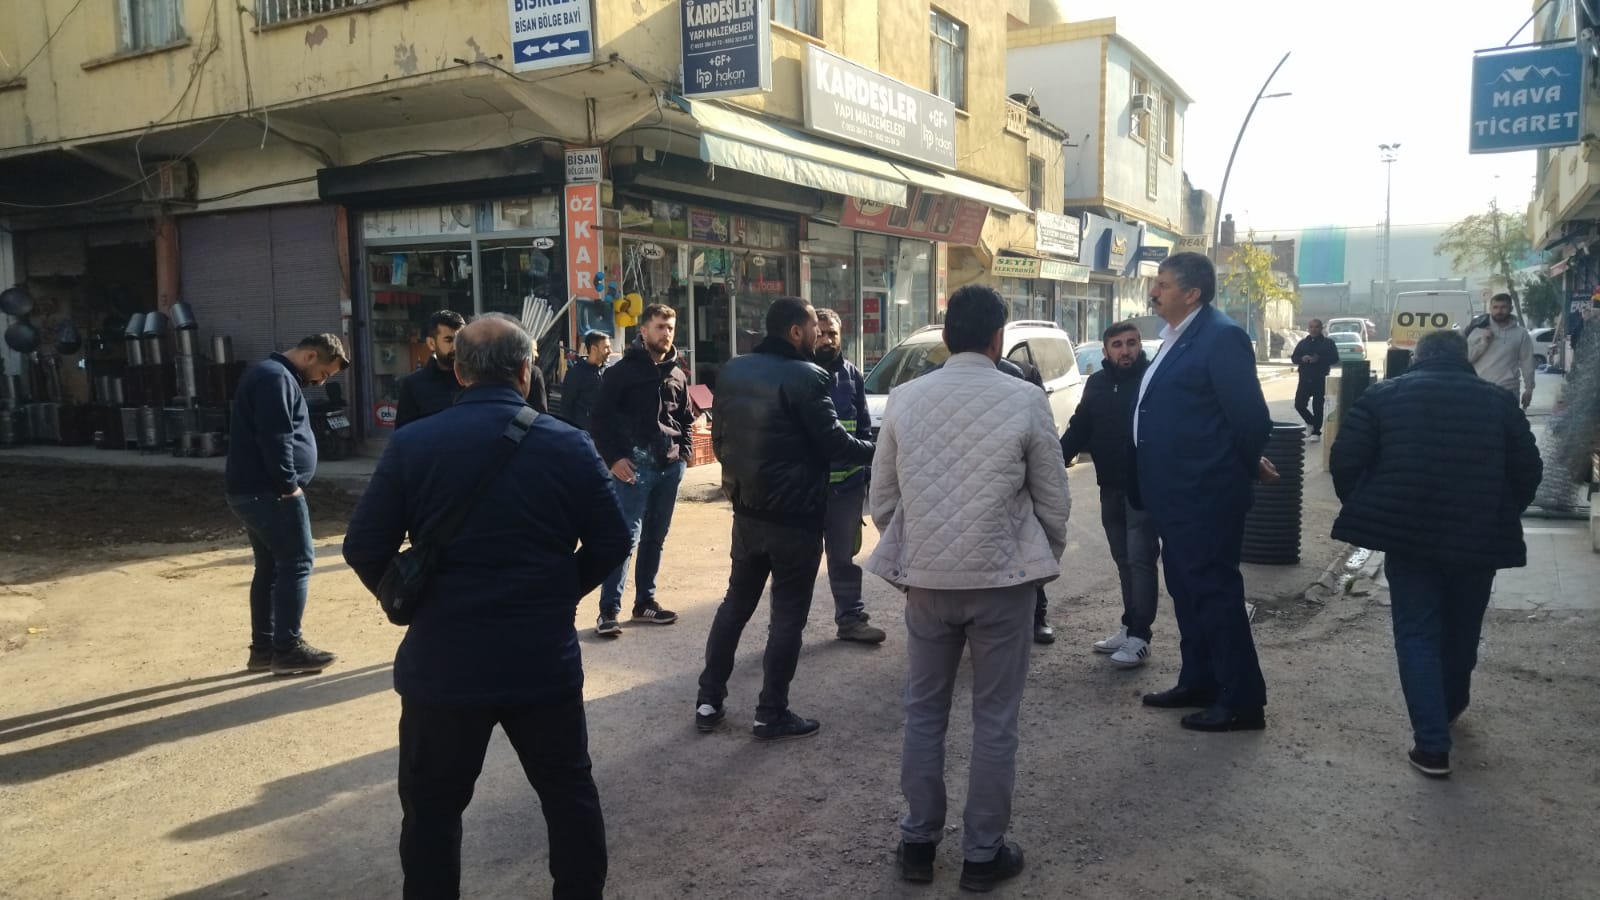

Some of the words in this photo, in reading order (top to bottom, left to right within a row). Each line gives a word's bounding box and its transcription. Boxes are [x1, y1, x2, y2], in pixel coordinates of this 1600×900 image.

[515, 17, 537, 33] BİSAN
[538, 12, 562, 29] BÖLGE
[563, 6, 581, 25] BAYİ
[687, 0, 754, 27] KARDEŞLER
[689, 29, 705, 41] YAPI
[706, 18, 754, 39] MALZEMELERİ
[715, 68, 745, 81] hakan
[815, 58, 918, 125] KARDEŞLER
[1492, 85, 1561, 108] MAVA
[833, 102, 853, 121] YAPI
[854, 108, 906, 138] MALZEMELERİ
[1474, 112, 1578, 136] TİCARET
[567, 153, 598, 166] BİSAN
[570, 195, 593, 212] ÖZ
[574, 220, 593, 300] KAR
[994, 265, 1036, 274] ELEKTRONİK
[996, 257, 1036, 267] SEYİT
[1397, 312, 1449, 328] OTO
